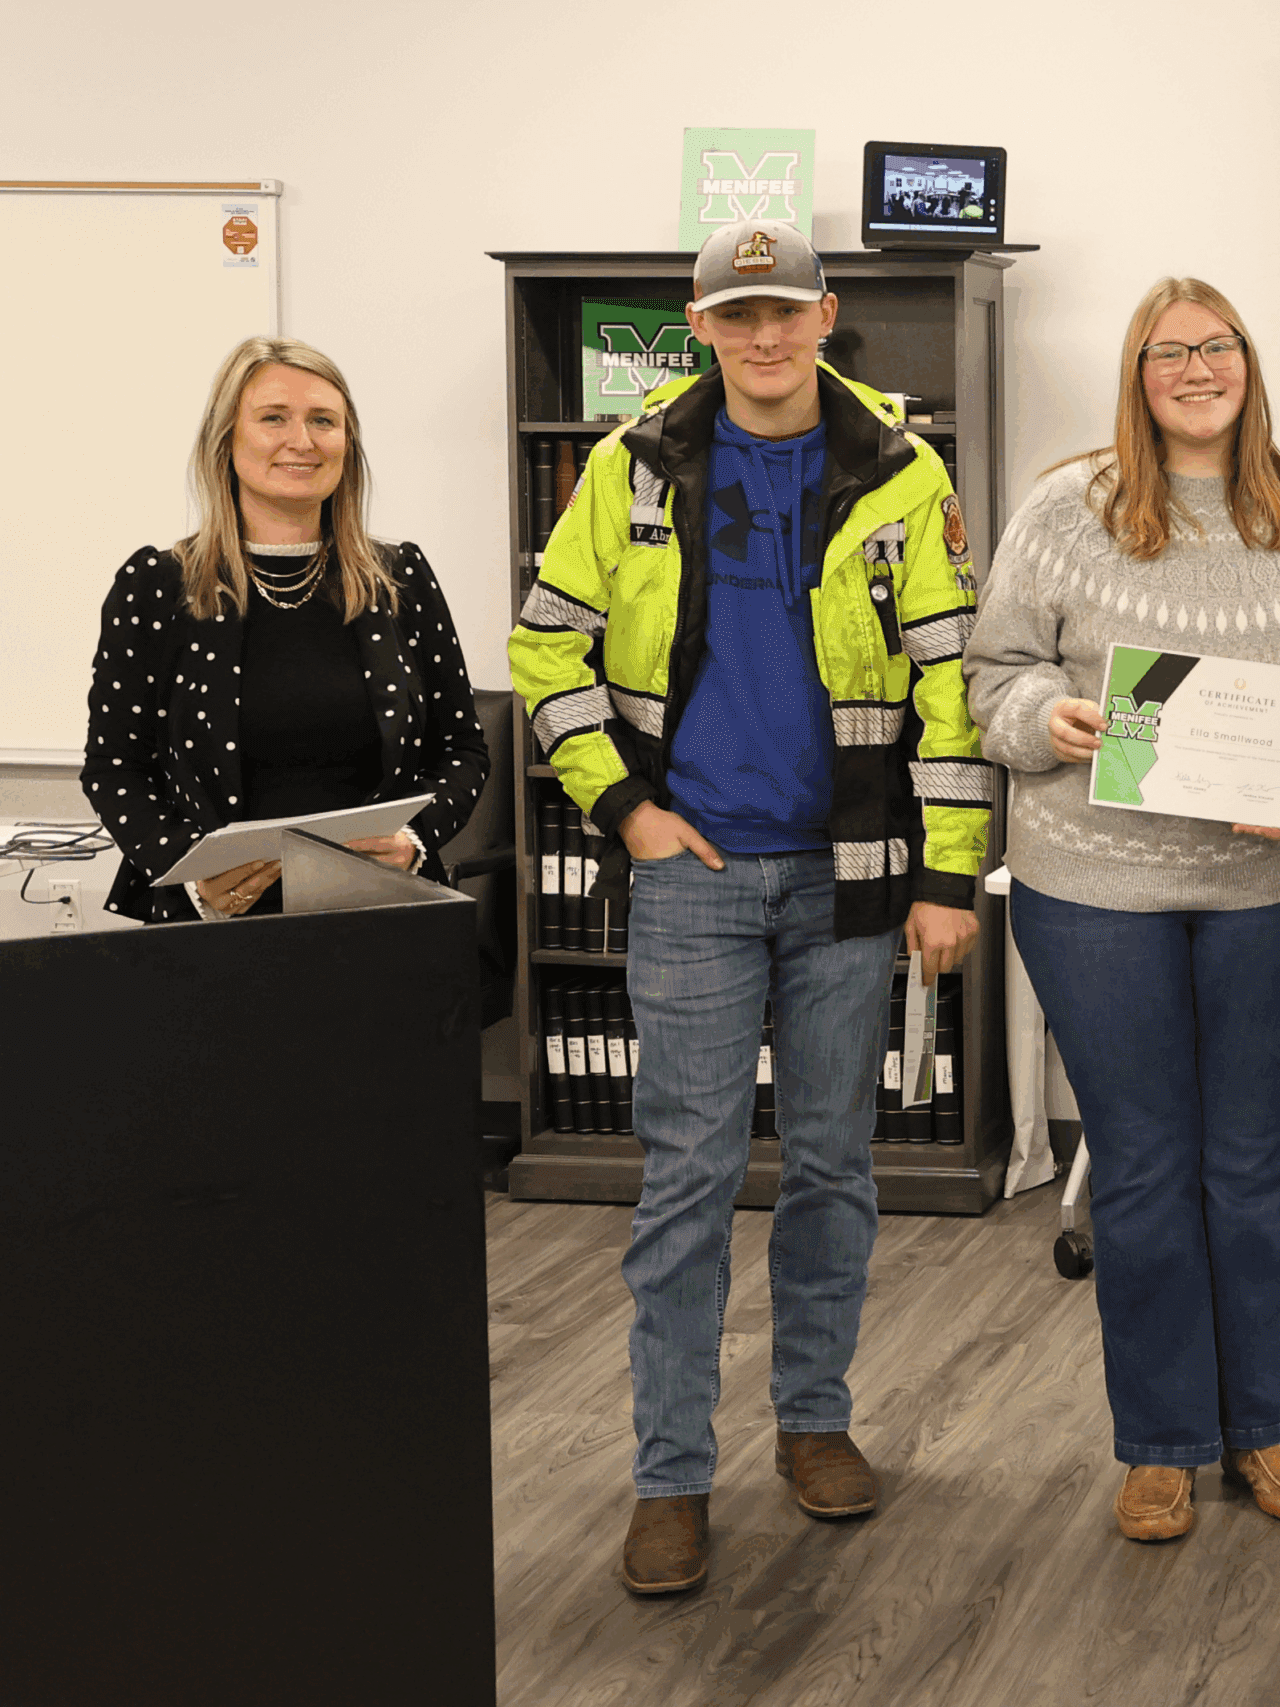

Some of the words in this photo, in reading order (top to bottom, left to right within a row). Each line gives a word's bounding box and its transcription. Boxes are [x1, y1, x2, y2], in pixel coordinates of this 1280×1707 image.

[702, 179, 795, 196] MENIFEE
[602, 352, 694, 368] MENIFEE
[635, 526, 645, 539] V
[1198, 688, 1277, 708] CERTIFICATE
[1216, 701, 1269, 714] ACHIEVEMENT
[1111, 711, 1159, 727] MENIFEE
[1190, 728, 1210, 739] Ella
[1213, 730, 1273, 747] Smallwood
